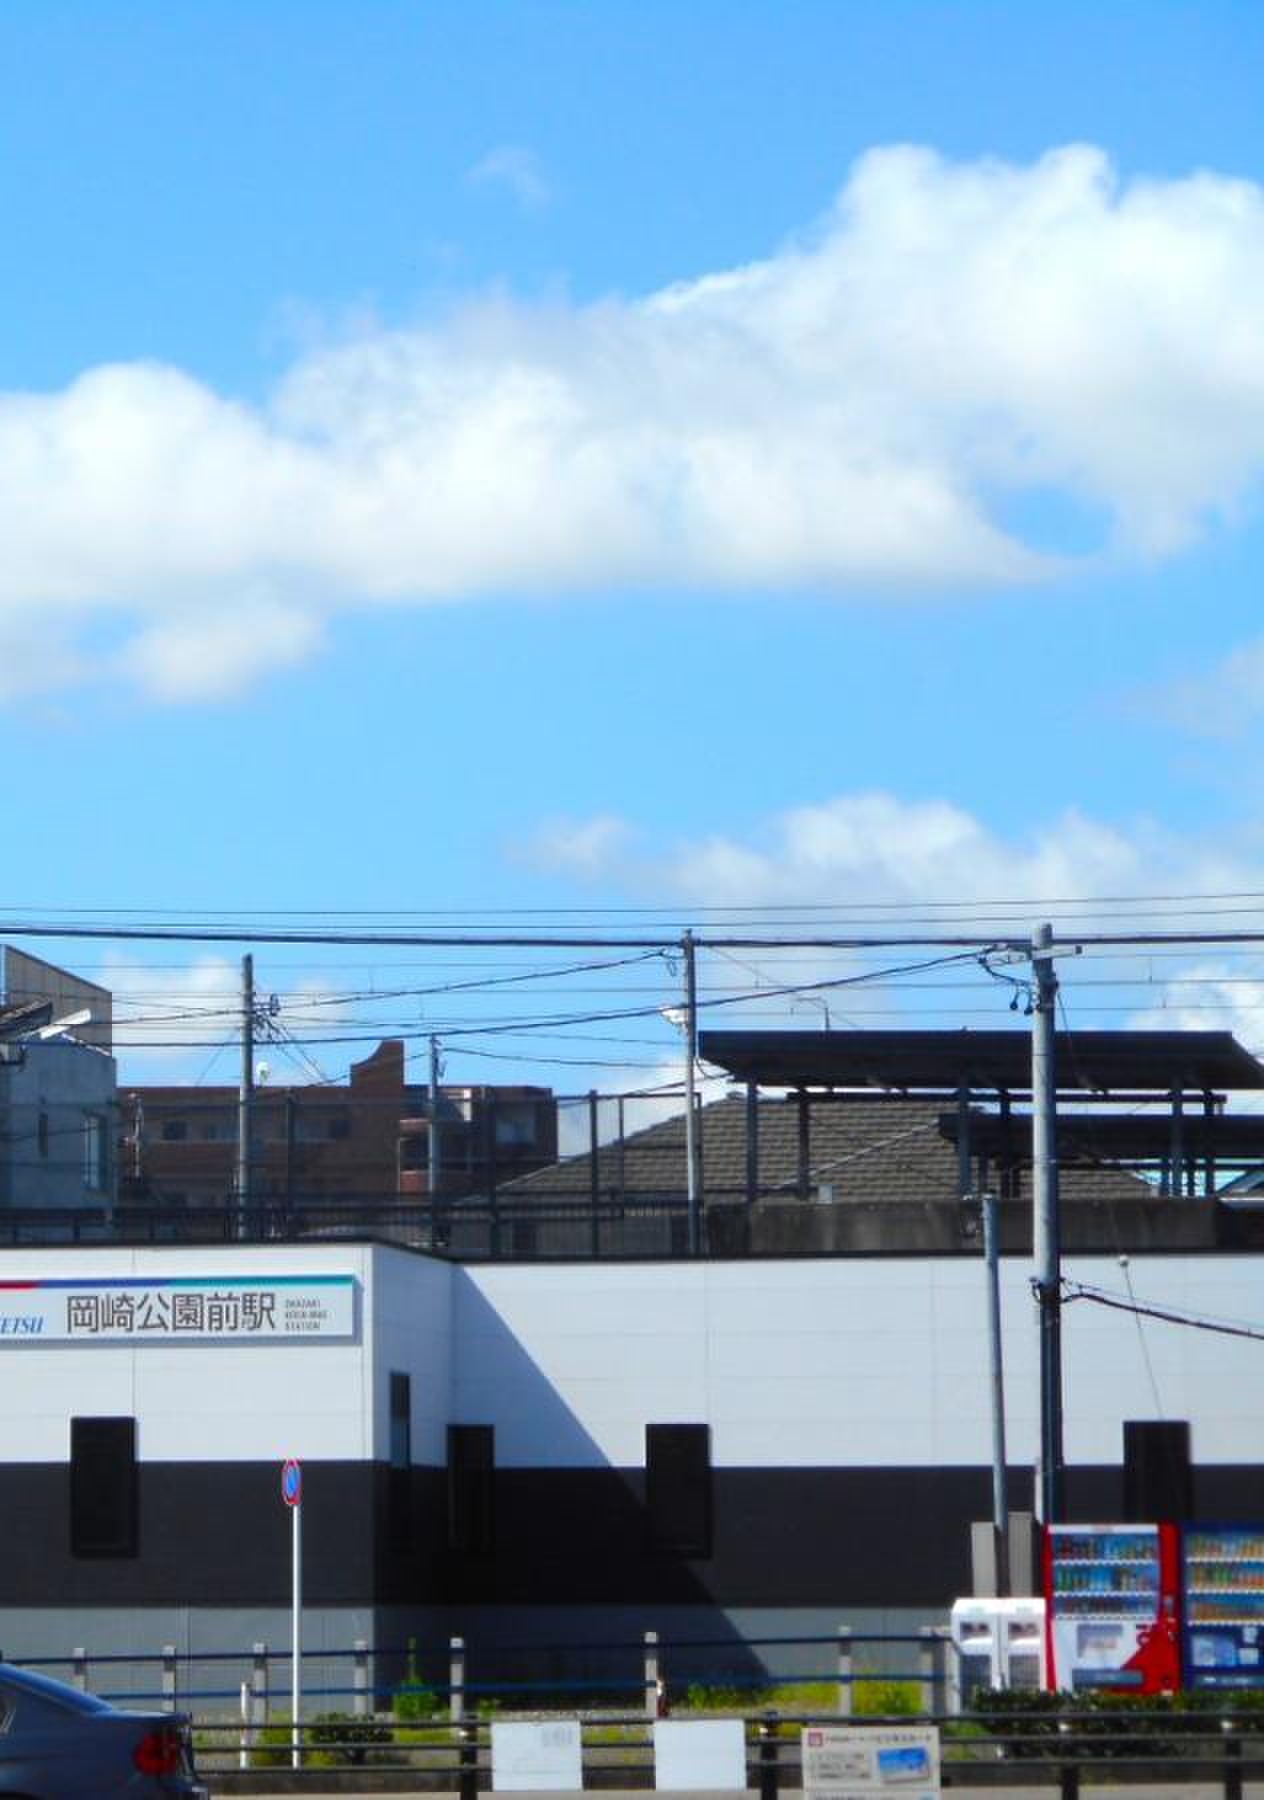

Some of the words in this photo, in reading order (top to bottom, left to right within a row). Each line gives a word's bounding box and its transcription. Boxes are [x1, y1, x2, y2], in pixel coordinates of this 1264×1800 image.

[67, 1292, 276, 1333] 岡崎公園前駅
